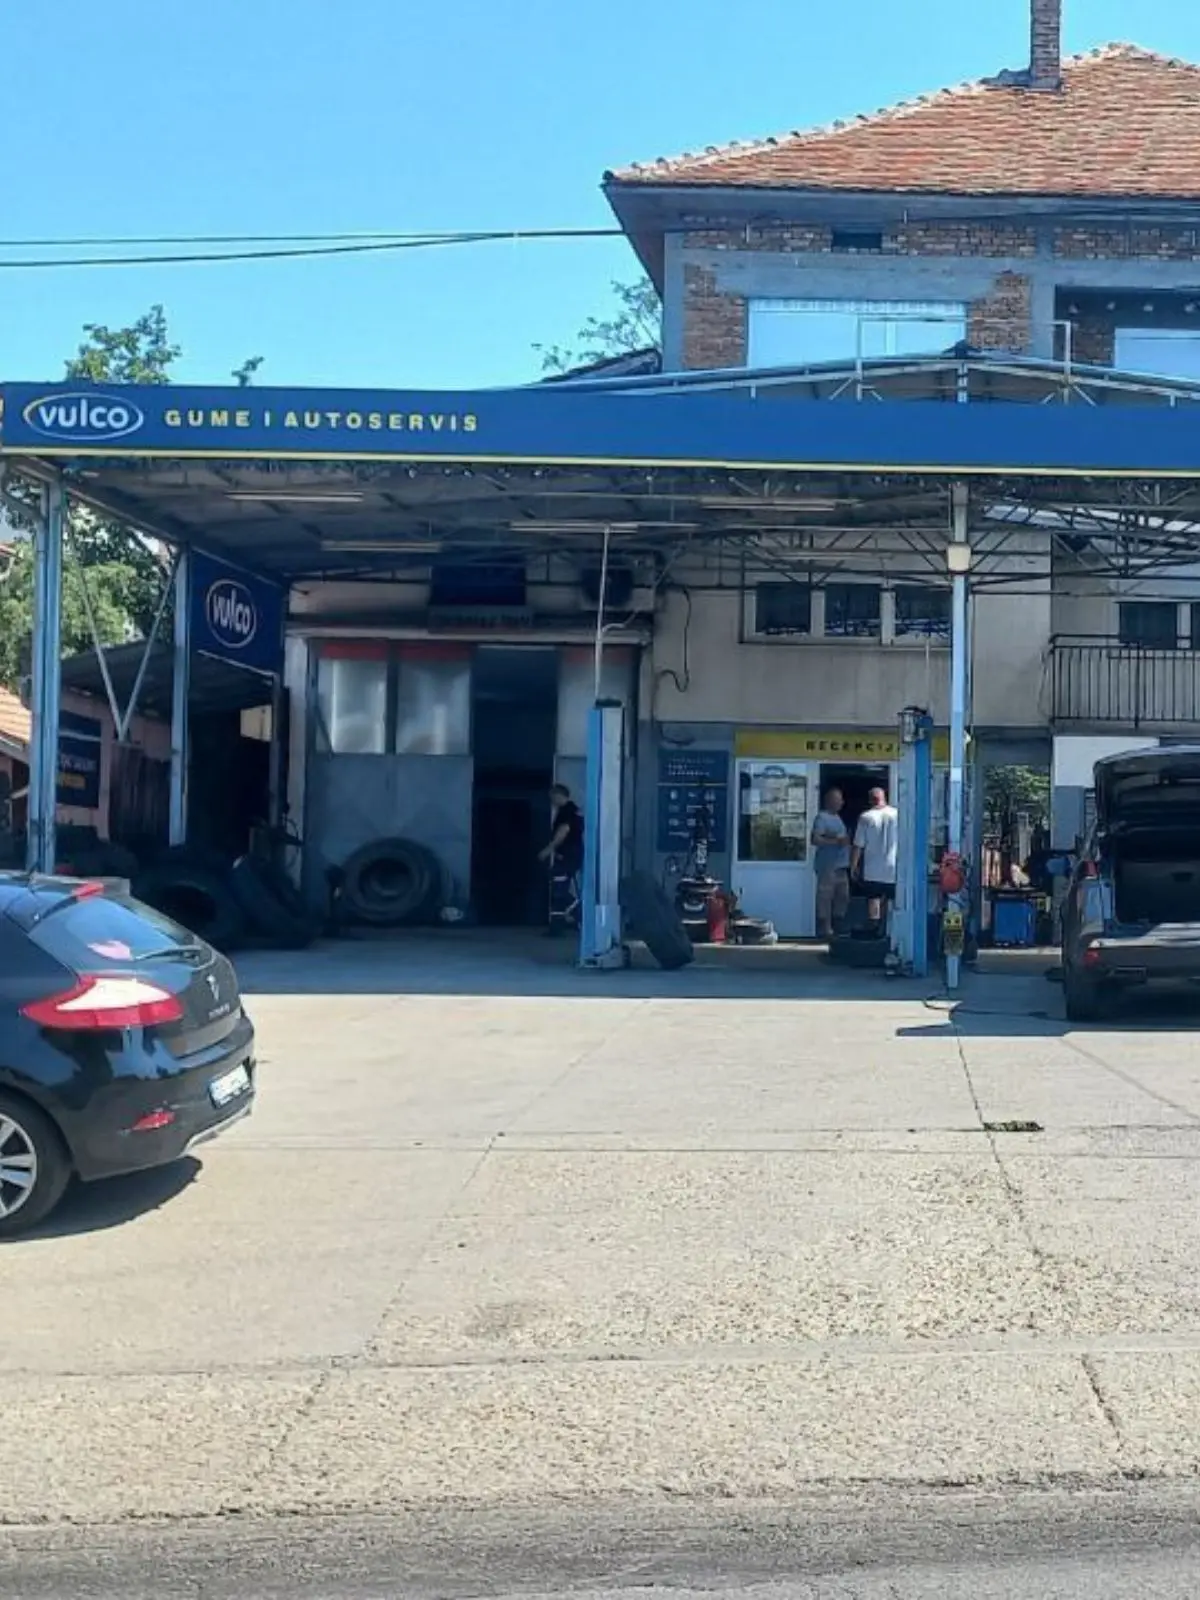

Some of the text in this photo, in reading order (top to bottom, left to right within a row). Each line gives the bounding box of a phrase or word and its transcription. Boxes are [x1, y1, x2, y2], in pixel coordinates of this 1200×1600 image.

[38, 399, 129, 429] vulco
[164, 410, 478, 432] GUME I AUTOSERVIS
[213, 588, 250, 635] vulco
[805, 740, 900, 753] RECEPCIJ
